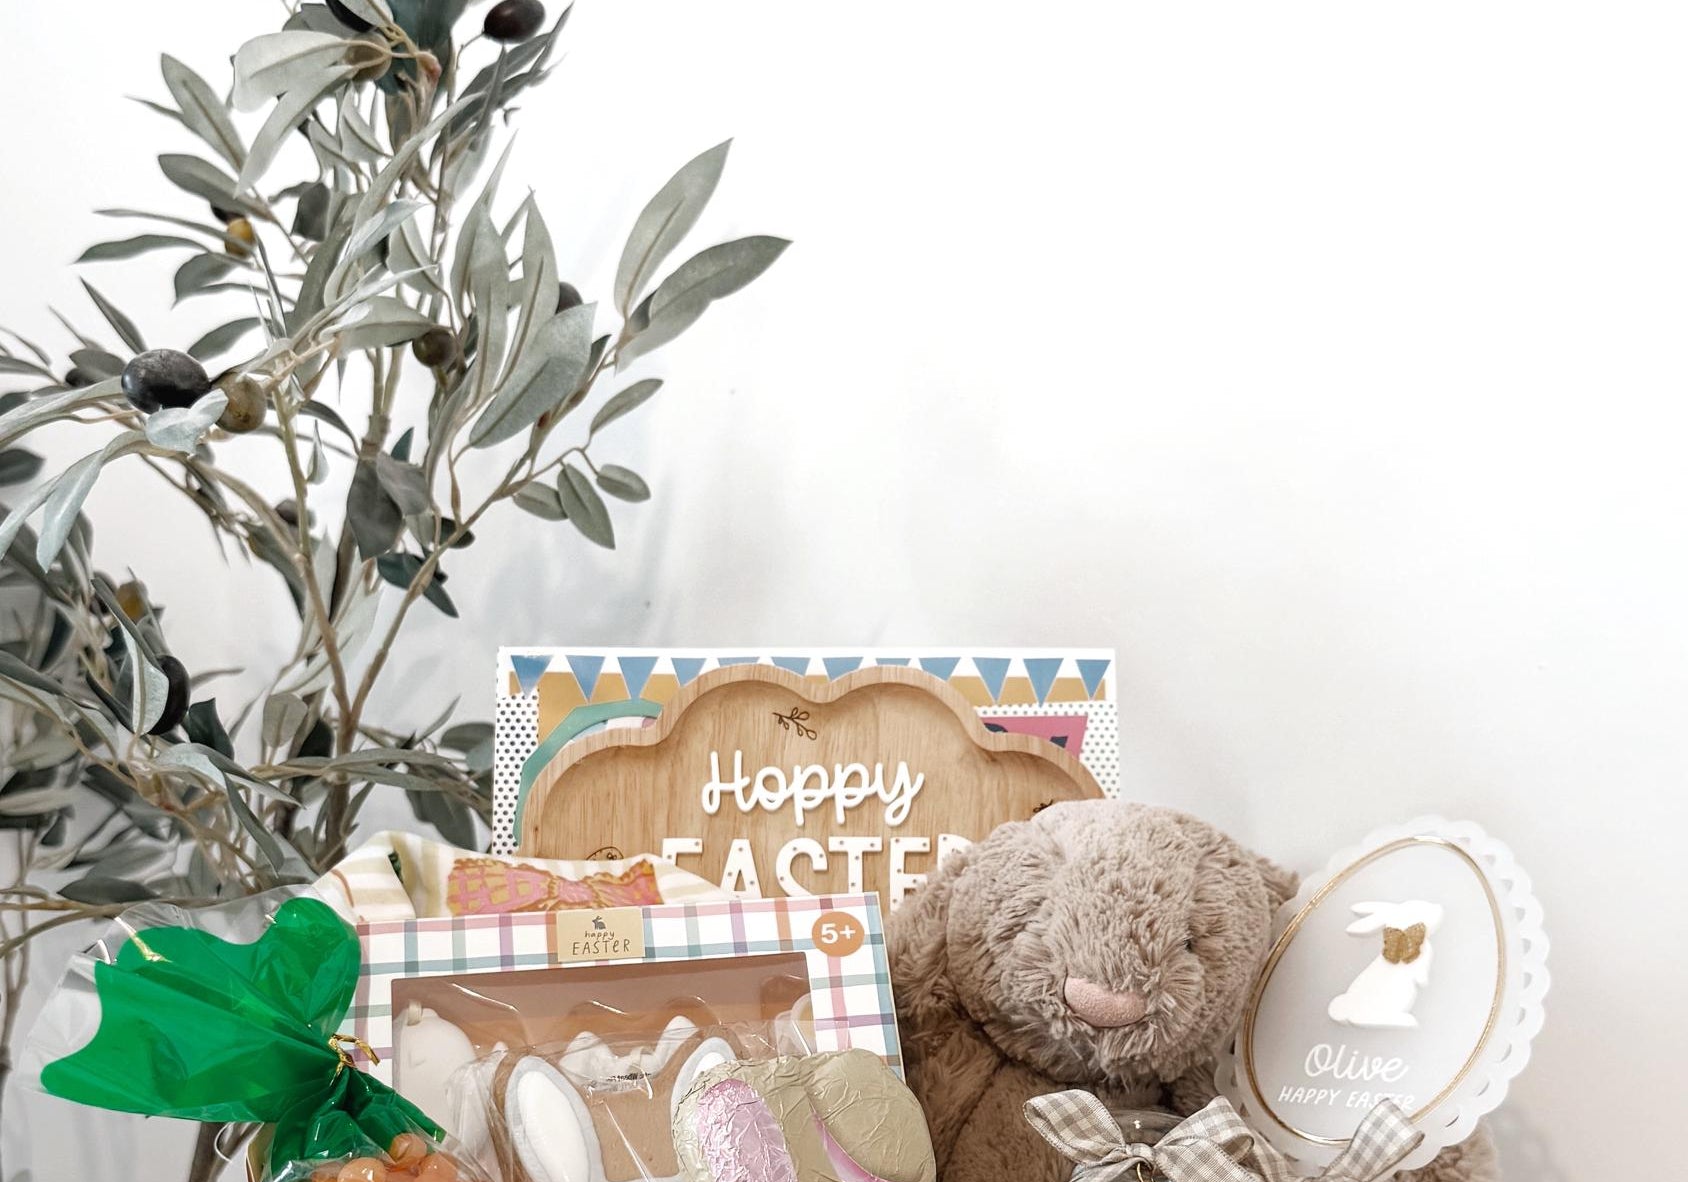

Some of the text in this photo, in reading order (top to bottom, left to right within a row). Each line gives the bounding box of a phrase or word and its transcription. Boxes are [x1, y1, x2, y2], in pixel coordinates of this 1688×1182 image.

[701, 749, 925, 827] Hoppy
[584, 930, 615, 941] happy
[821, 922, 856, 944] 5+
[1304, 1043, 1409, 1082] Olive
[1278, 1085, 1342, 1106] HAPPY
